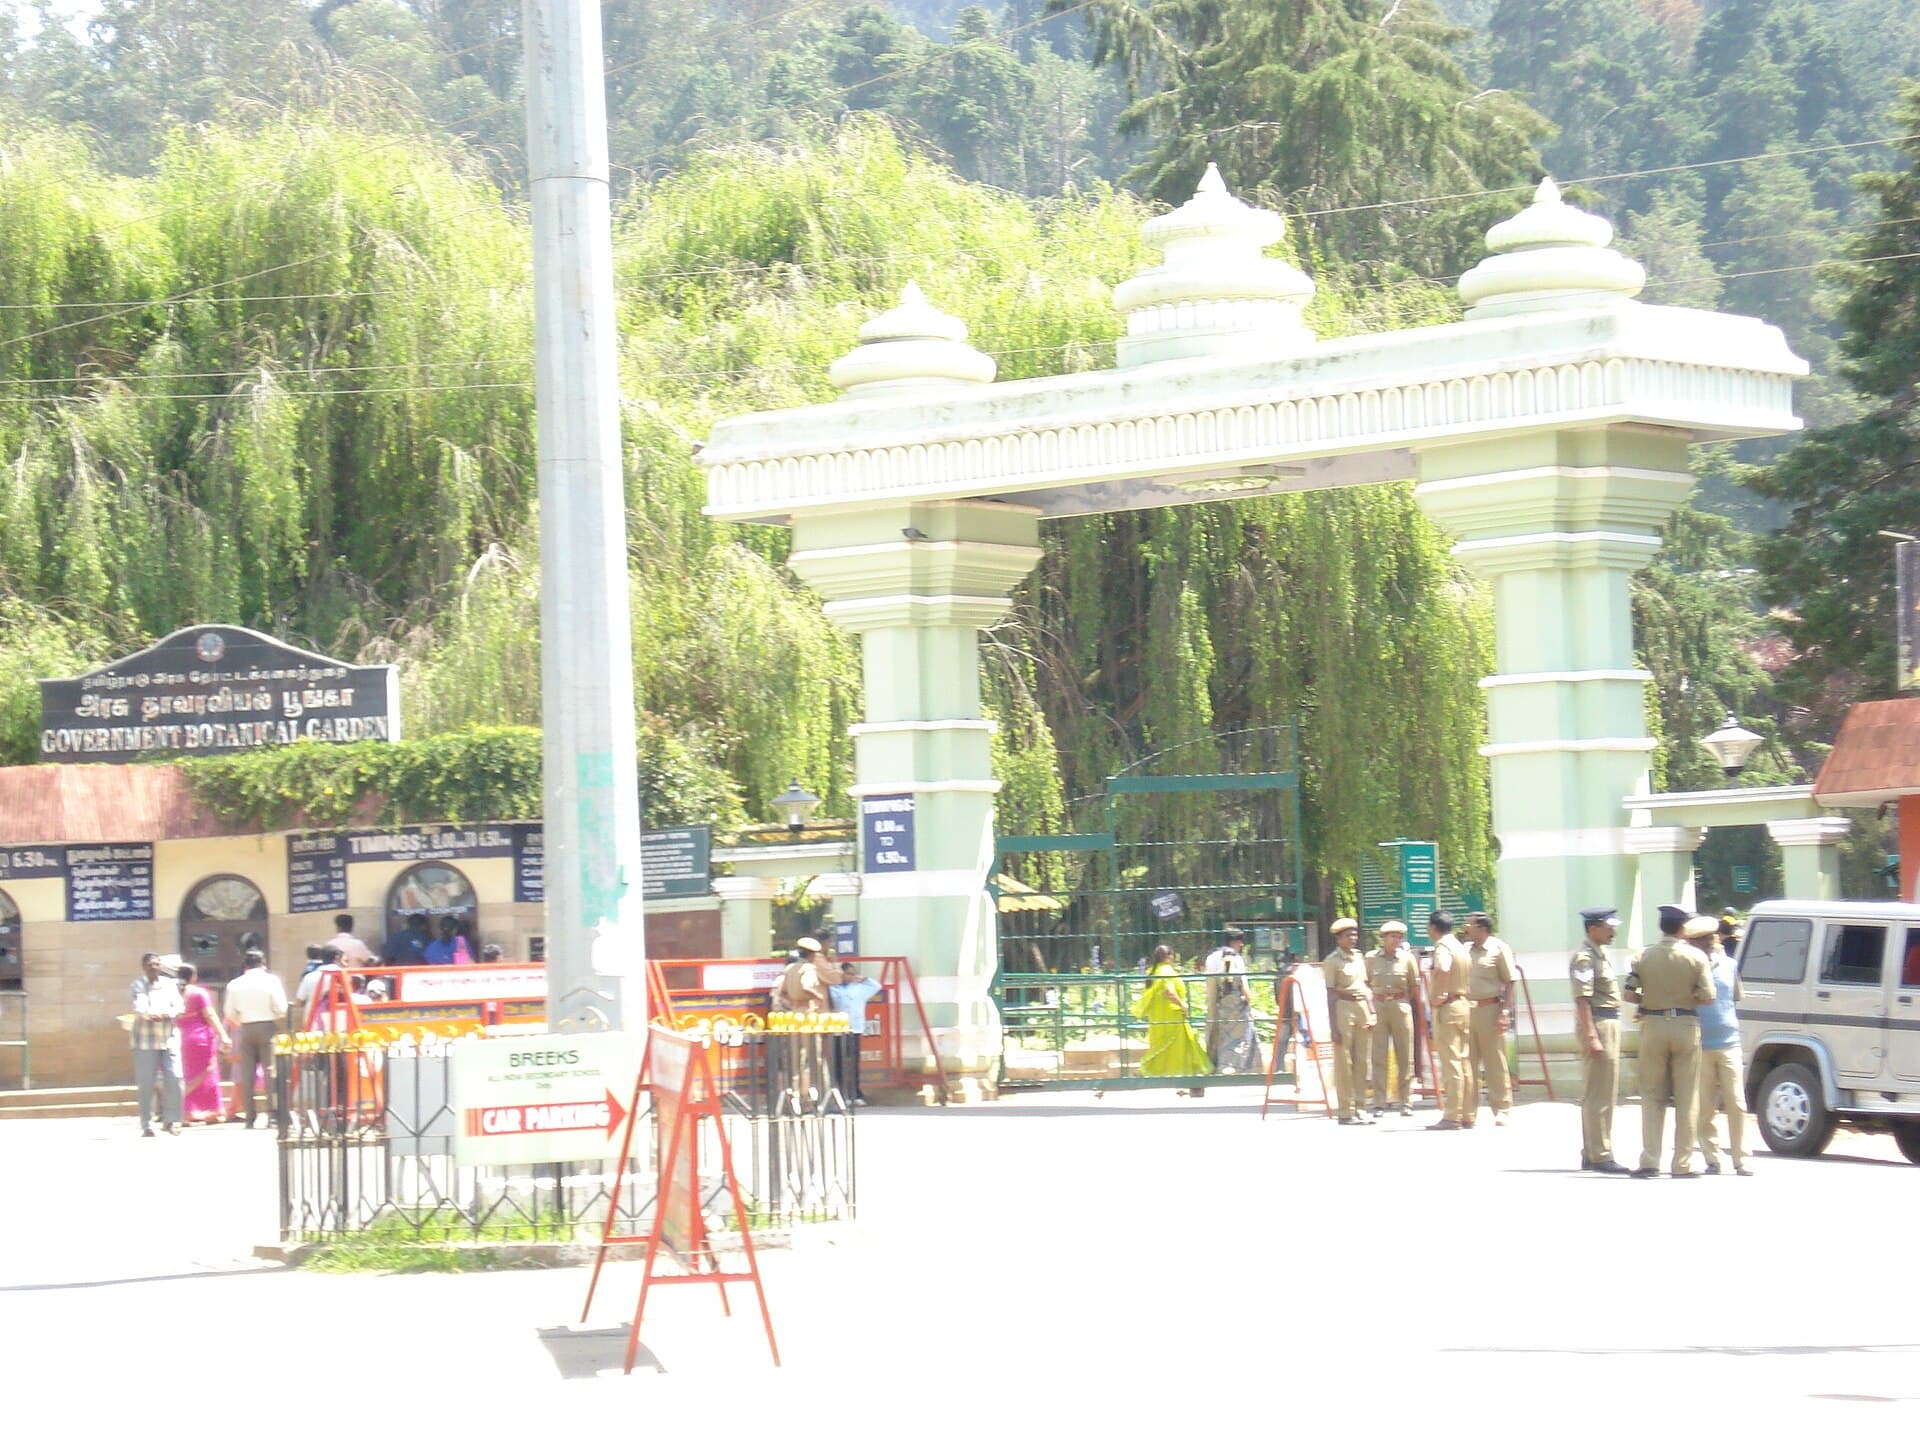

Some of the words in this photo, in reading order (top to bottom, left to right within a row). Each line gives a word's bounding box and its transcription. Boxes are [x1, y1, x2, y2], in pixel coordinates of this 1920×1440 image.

[74, 694, 129, 720] அரசு
[281, 682, 355, 718] பூங்கா
[41, 725, 182, 753] GOVERNMENT
[184, 719, 298, 749] BOTANICAL
[305, 715, 387, 743] GARDEN
[510, 1050, 579, 1067] BREEKS
[483, 1109, 521, 1133] CAR
[525, 1103, 610, 1130] PARKING
